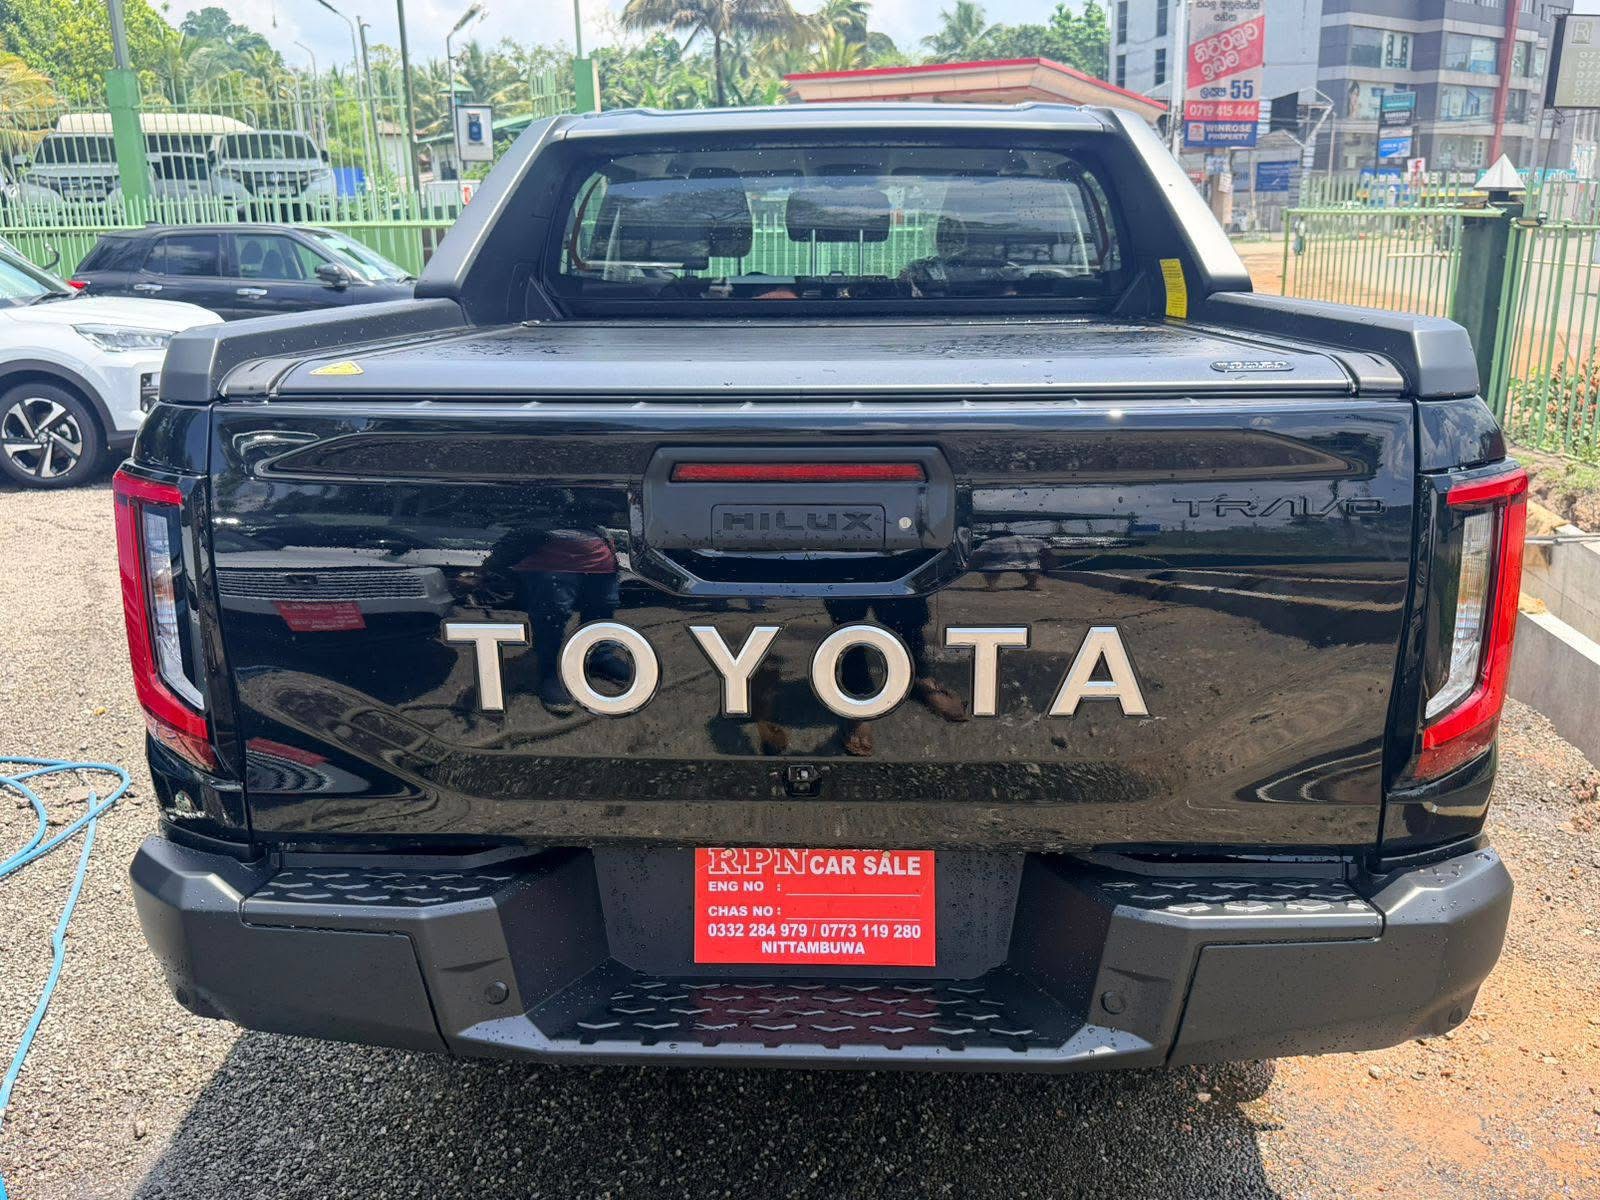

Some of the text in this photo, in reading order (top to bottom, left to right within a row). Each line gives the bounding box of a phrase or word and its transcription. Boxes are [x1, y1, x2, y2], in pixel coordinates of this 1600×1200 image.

[1230, 79, 1254, 99] 55
[1189, 104, 1256, 118] 0719 415 444
[1205, 124, 1253, 133] WINROSE
[1207, 133, 1249, 142] PROPERTY
[722, 512, 874, 531] HILUX
[444, 621, 1151, 719] TOYOTA
[708, 848, 921, 876] RPN CAR SALE
[708, 881, 739, 892] ENG
[743, 881, 764, 892] NO
[708, 905, 748, 917] CHAS
[708, 924, 745, 938] 0332
[749, 924, 776, 938] 284
[780, 924, 808, 938] 979
[820, 924, 857, 938] 0773
[862, 924, 889, 938] 119
[893, 924, 922, 939] 280
[761, 941, 866, 955] NITTAMBUWA
